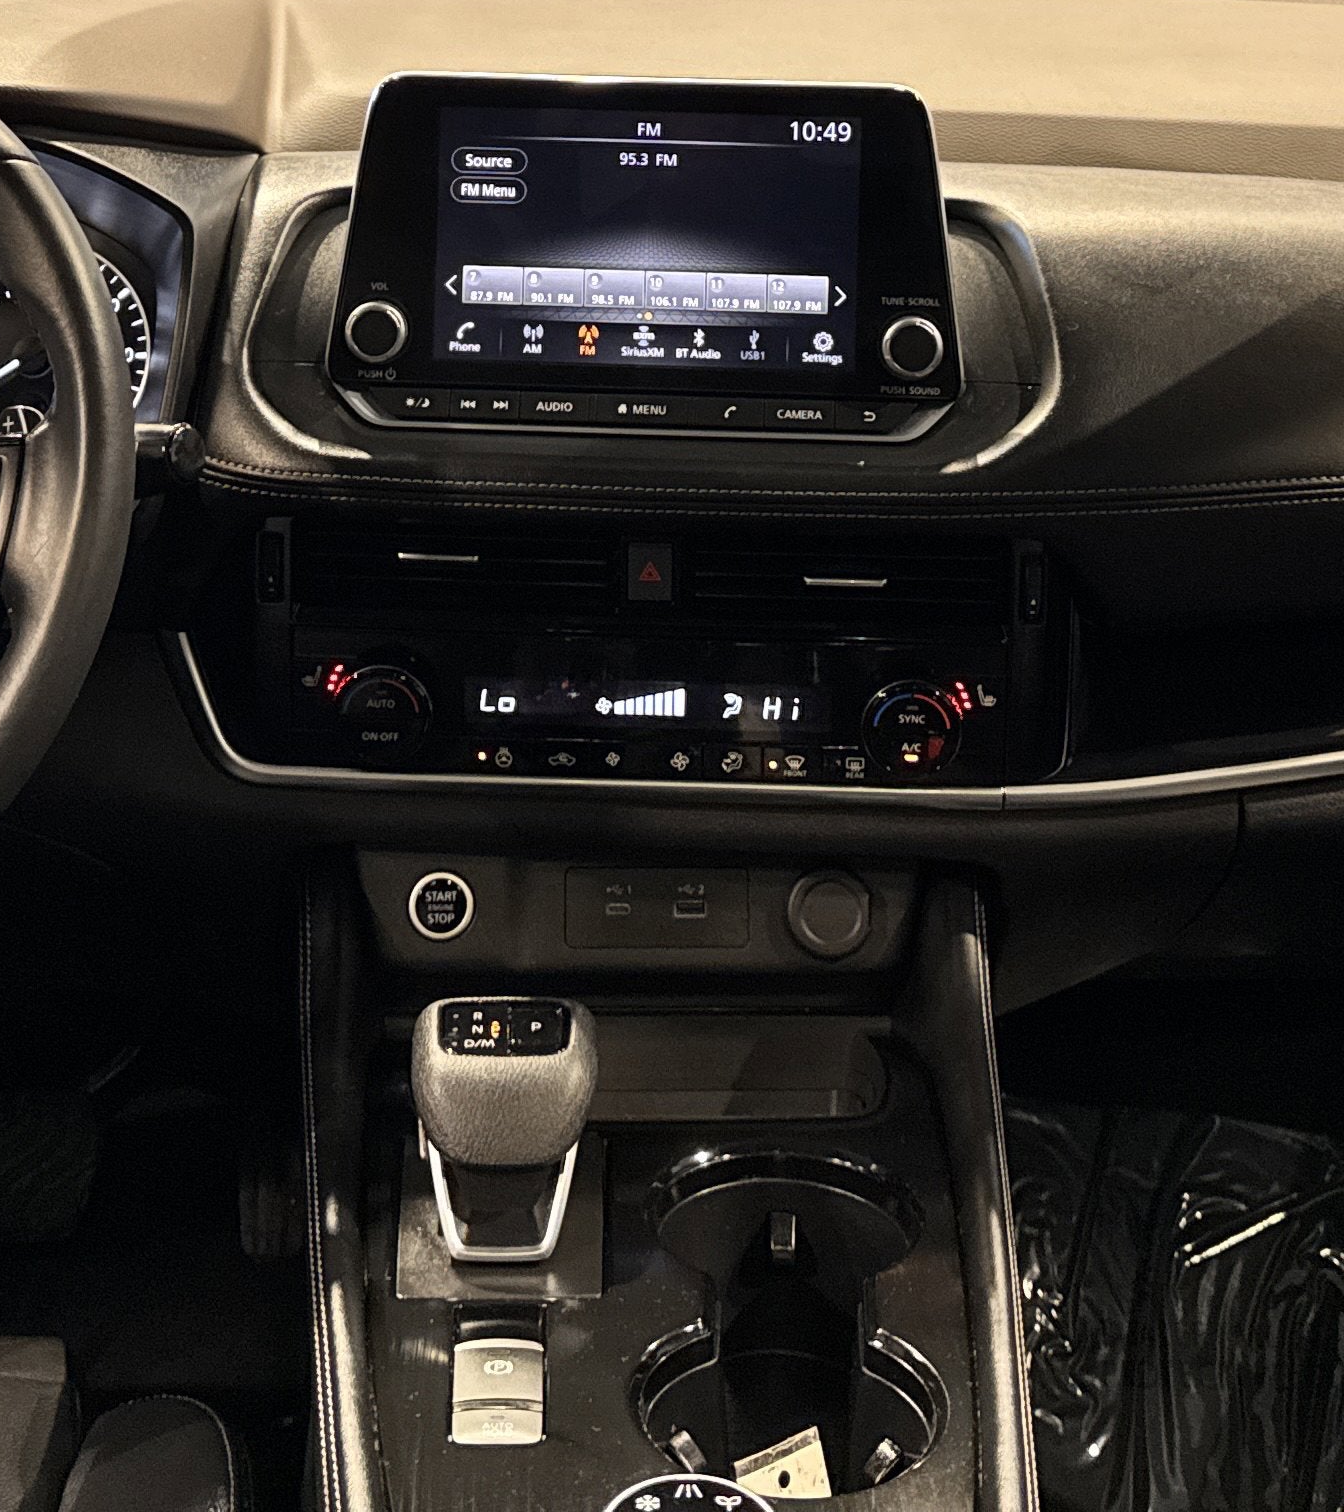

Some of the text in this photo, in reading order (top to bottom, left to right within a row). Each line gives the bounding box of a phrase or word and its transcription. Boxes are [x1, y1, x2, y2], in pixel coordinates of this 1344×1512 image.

[637, 121, 662, 137] FM
[789, 120, 852, 142] 10:49
[465, 153, 513, 169] Source
[619, 152, 678, 167] 95.3 FM
[460, 182, 516, 198] FM Menu
[469, 272, 477, 282] 7
[649, 276, 663, 288] 10
[370, 281, 390, 291] VOL
[710, 278, 724, 290] 11
[771, 280, 785, 292] 12
[470, 291, 514, 302] 87.9 FM
[530, 292, 574, 304] 90.1 FM
[591, 294, 635, 306] 98.5 FM
[650, 295, 699, 308] 106.1 FM
[711, 297, 760, 310] 107.9 FM
[773, 300, 822, 312] 107.9 FM
[448, 341, 481, 353] Phone
[522, 343, 542, 354] AM
[579, 344, 596, 356] FM
[620, 345, 665, 359] SiriusXM
[675, 348, 721, 360] BT Audio
[740, 350, 766, 361] USB1
[801, 351, 843, 366] Settings
[357, 369, 383, 379] PUSH
[909, 386, 941, 397] SOUND
[535, 400, 574, 413] AUDIO
[632, 404, 667, 416] MENU
[776, 408, 823, 421] CAMERA
[366, 699, 396, 709] AUTO
[479, 688, 516, 713] Lo
[762, 696, 800, 721] Hi
[898, 714, 926, 725] SYNC
[901, 742, 922, 753] A/C
[425, 890, 457, 902] START
[427, 913, 455, 925] STOP
[472, 1011, 483, 1021] R
[471, 1024, 484, 1035] N
[530, 1021, 543, 1032] P
[463, 1038, 496, 1049] D/M
